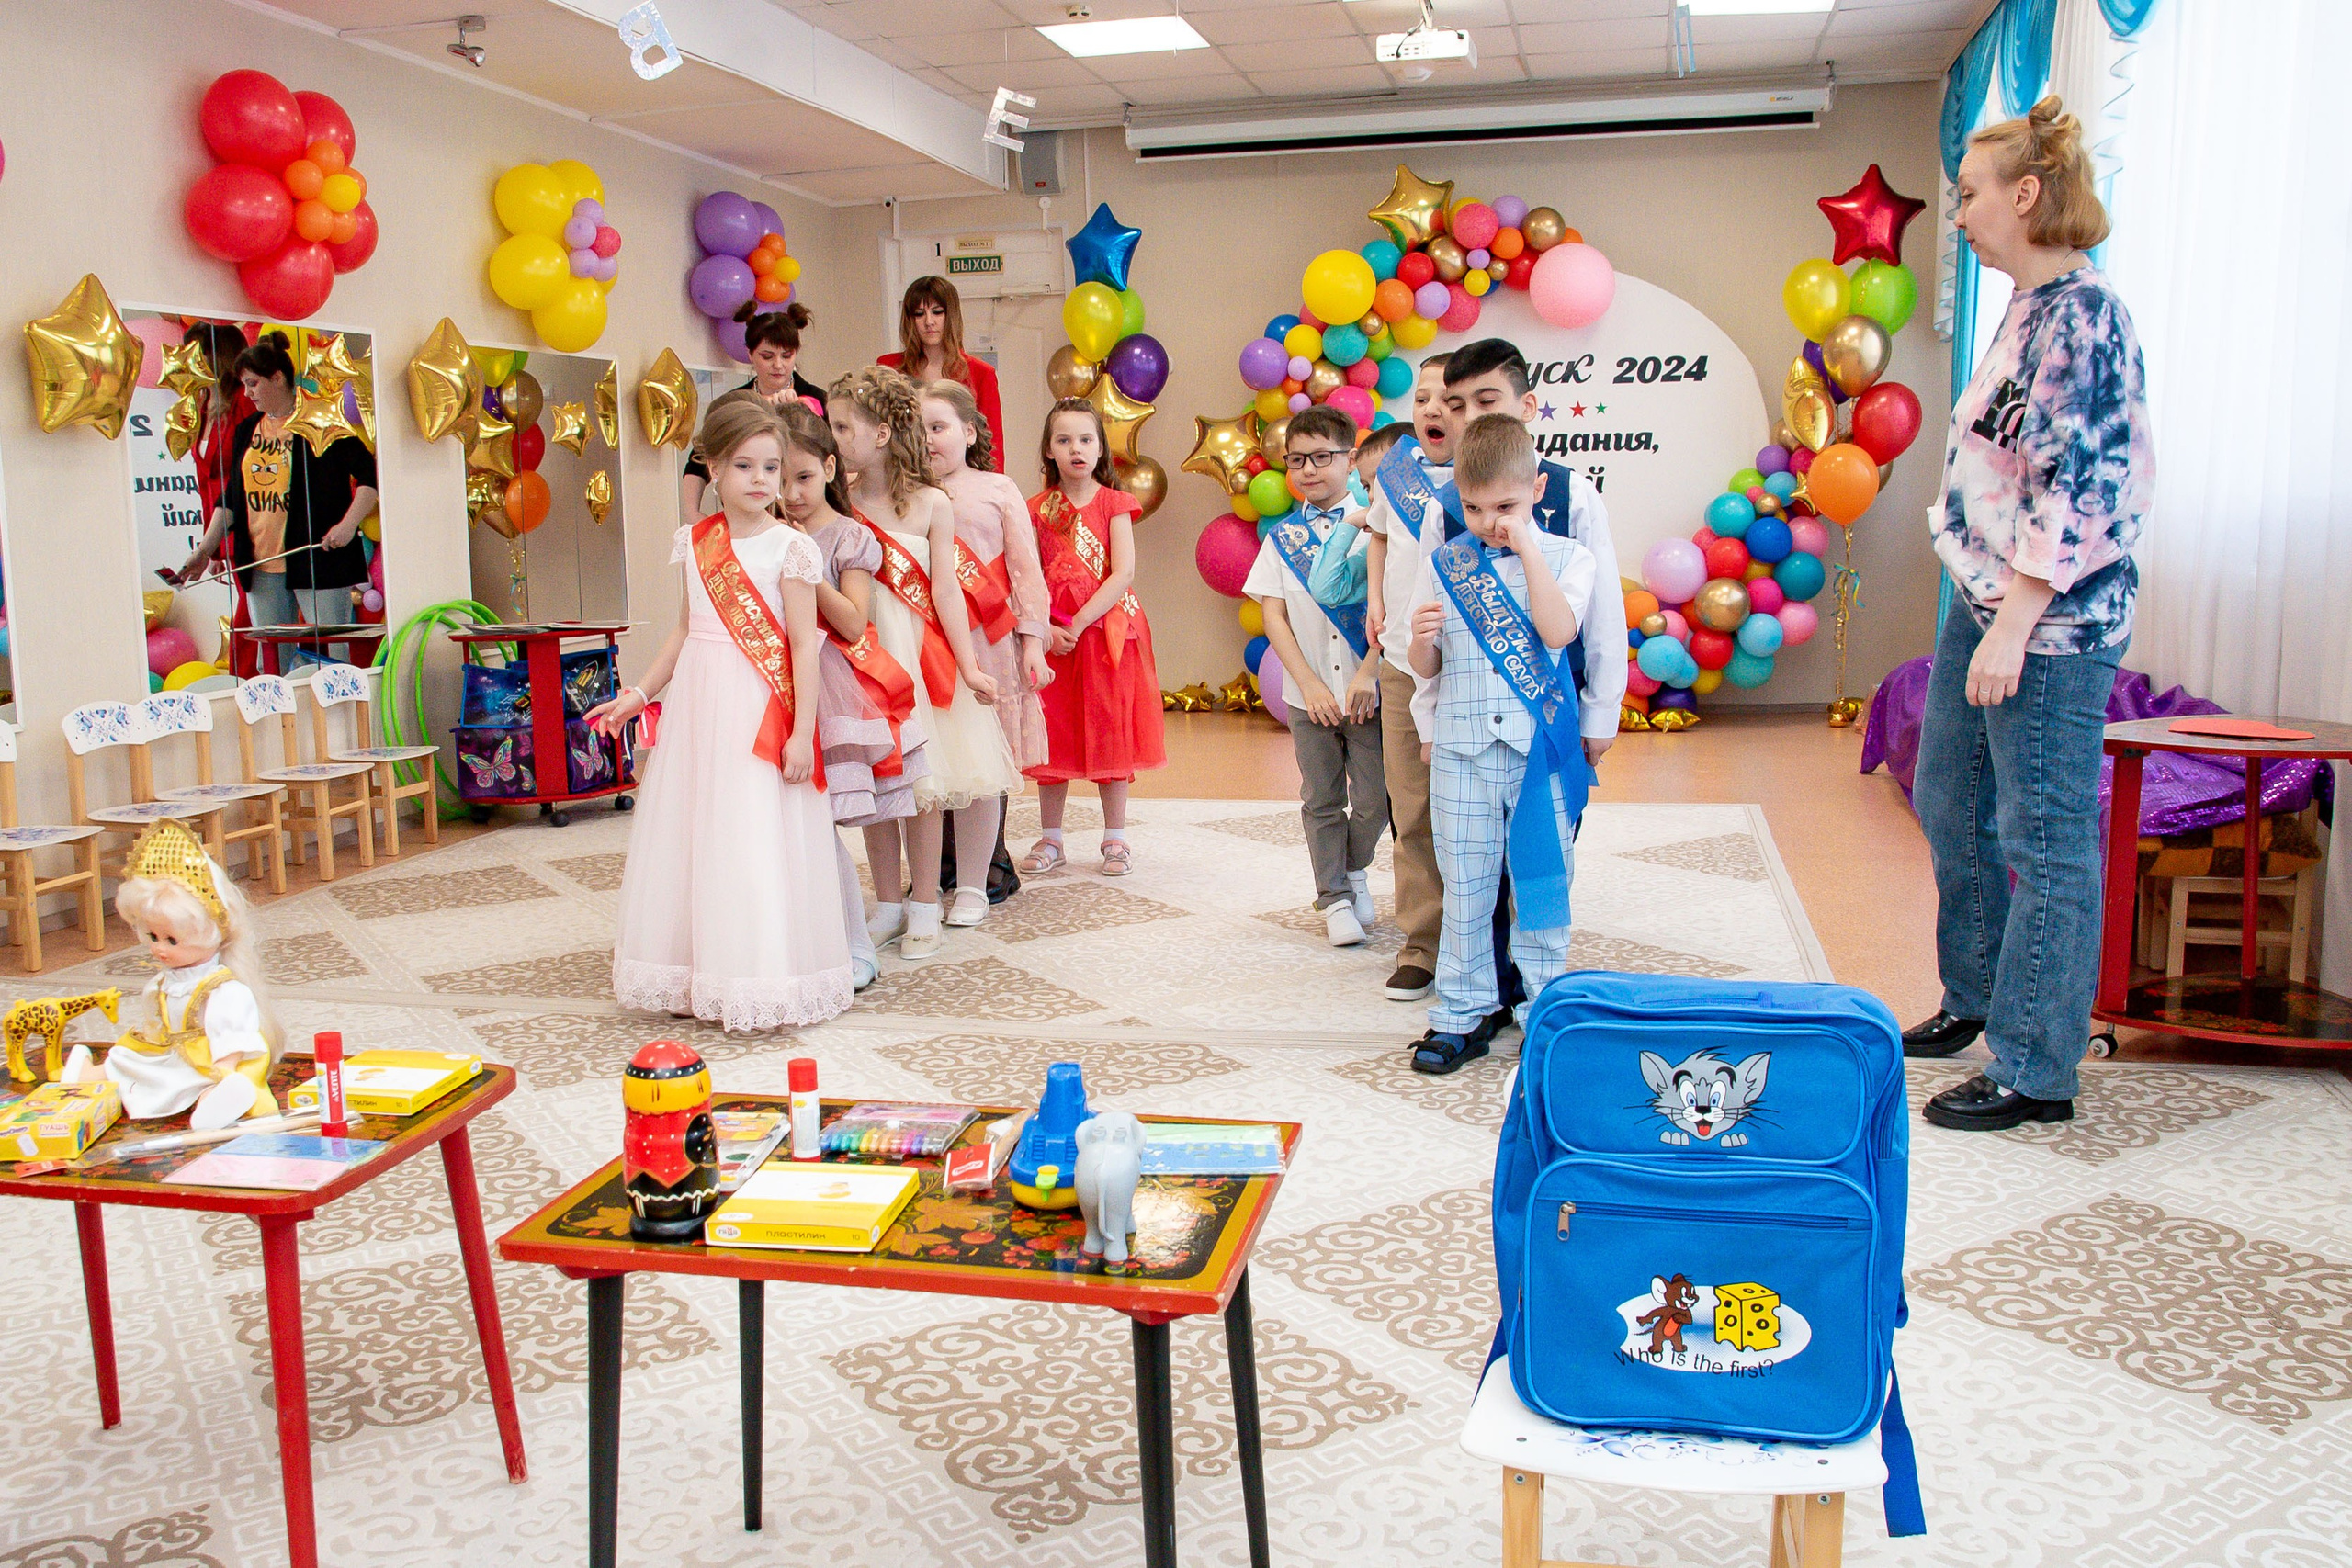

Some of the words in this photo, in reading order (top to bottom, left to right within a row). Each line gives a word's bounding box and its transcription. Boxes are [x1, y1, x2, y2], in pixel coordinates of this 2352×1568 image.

[935, 243, 941, 256] 1
[952, 258, 1000, 272] ВЫХОД
[1526, 353, 1595, 391] уск
[1611, 355, 1709, 384] 2024
[1530, 431, 1659, 457] идания,
[708, 571, 747, 627] ДЕТСКОГО
[740, 626, 769, 660] САДА
[719, 560, 784, 658] Выпускник
[1452, 582, 1509, 654] ДЕТСКОГО
[1504, 654, 1540, 700] САДА
[1468, 571, 1549, 695] Выпускник
[1613, 1347, 1664, 1366] Who
[1671, 1351, 1686, 1366] is
[1693, 1353, 1724, 1375] the
[1729, 1359, 1775, 1379] first?
